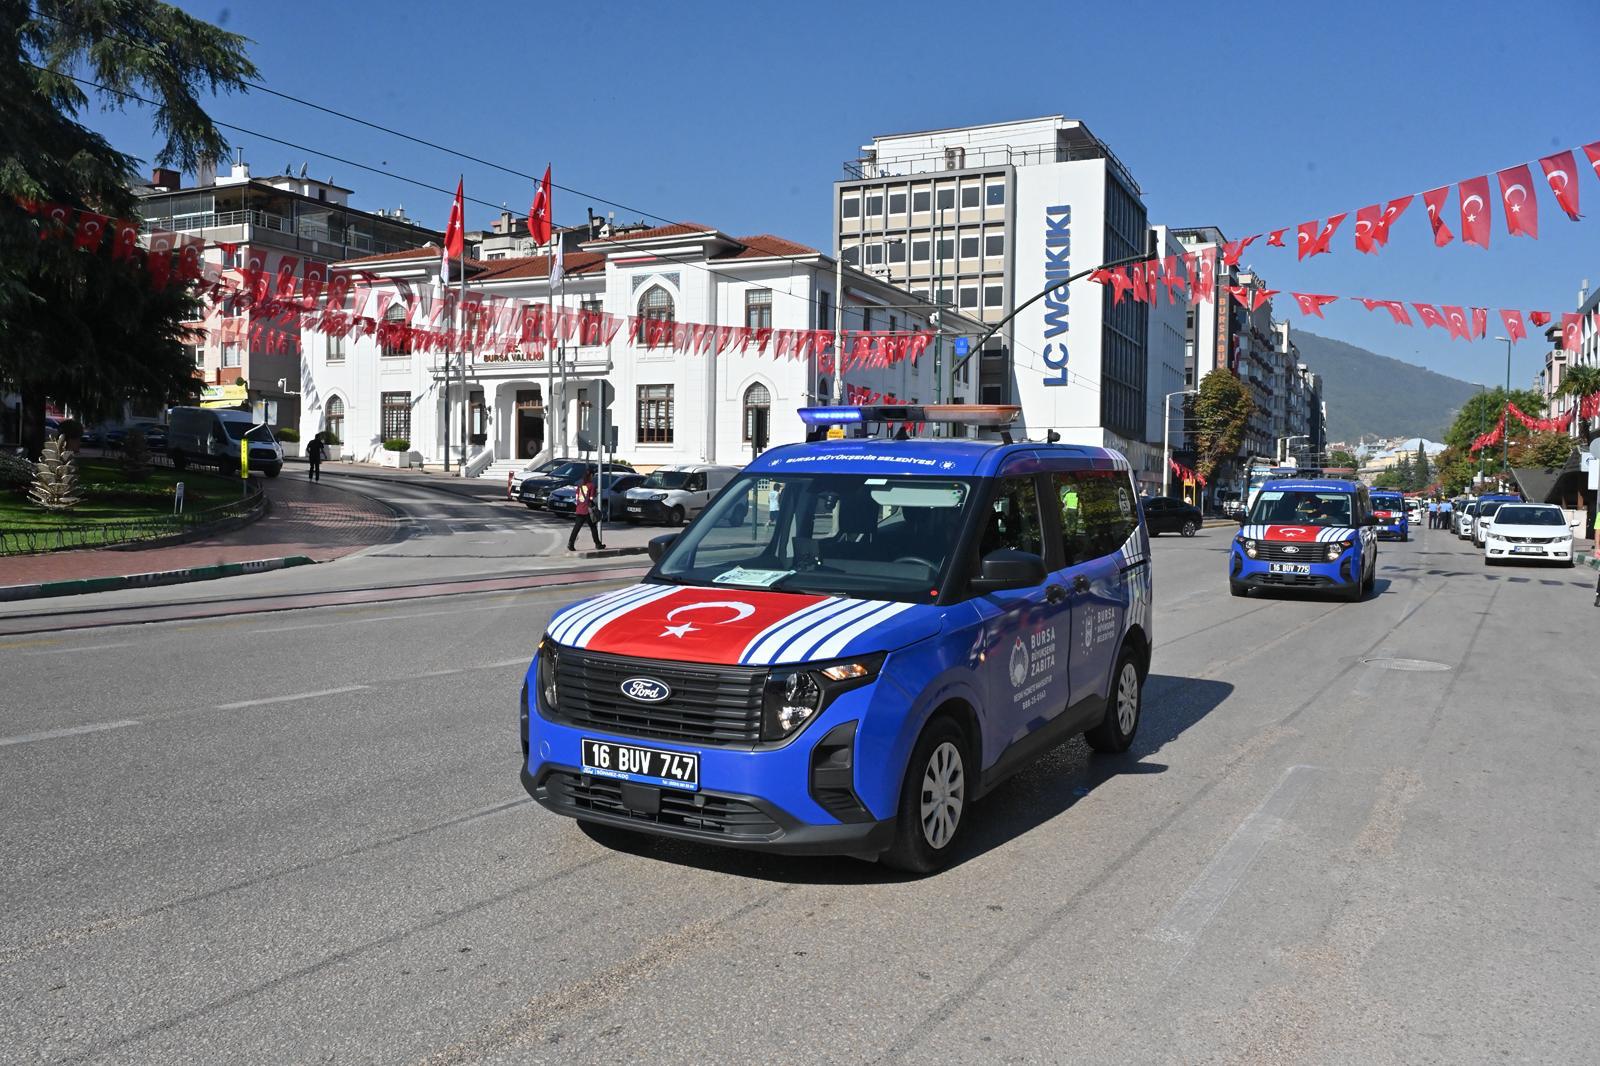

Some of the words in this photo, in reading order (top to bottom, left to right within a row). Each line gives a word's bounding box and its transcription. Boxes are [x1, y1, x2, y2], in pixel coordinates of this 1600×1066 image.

[1218, 297, 1226, 341] BURSA
[483, 354, 509, 362] BURSA
[1043, 342, 1070, 387] LC
[785, 456, 816, 464] BURSA
[877, 456, 936, 466] BELEDİYESİ
[1273, 563, 1280, 571] 16
[1282, 564, 1295, 572] BUV
[1296, 565, 1309, 573] 775
[1031, 626, 1056, 650] BURSA
[1031, 654, 1055, 677] ZABITA
[629, 680, 660, 699] Ford
[592, 743, 610, 768] 16
[618, 748, 651, 774] BUV
[660, 753, 694, 780] 747
